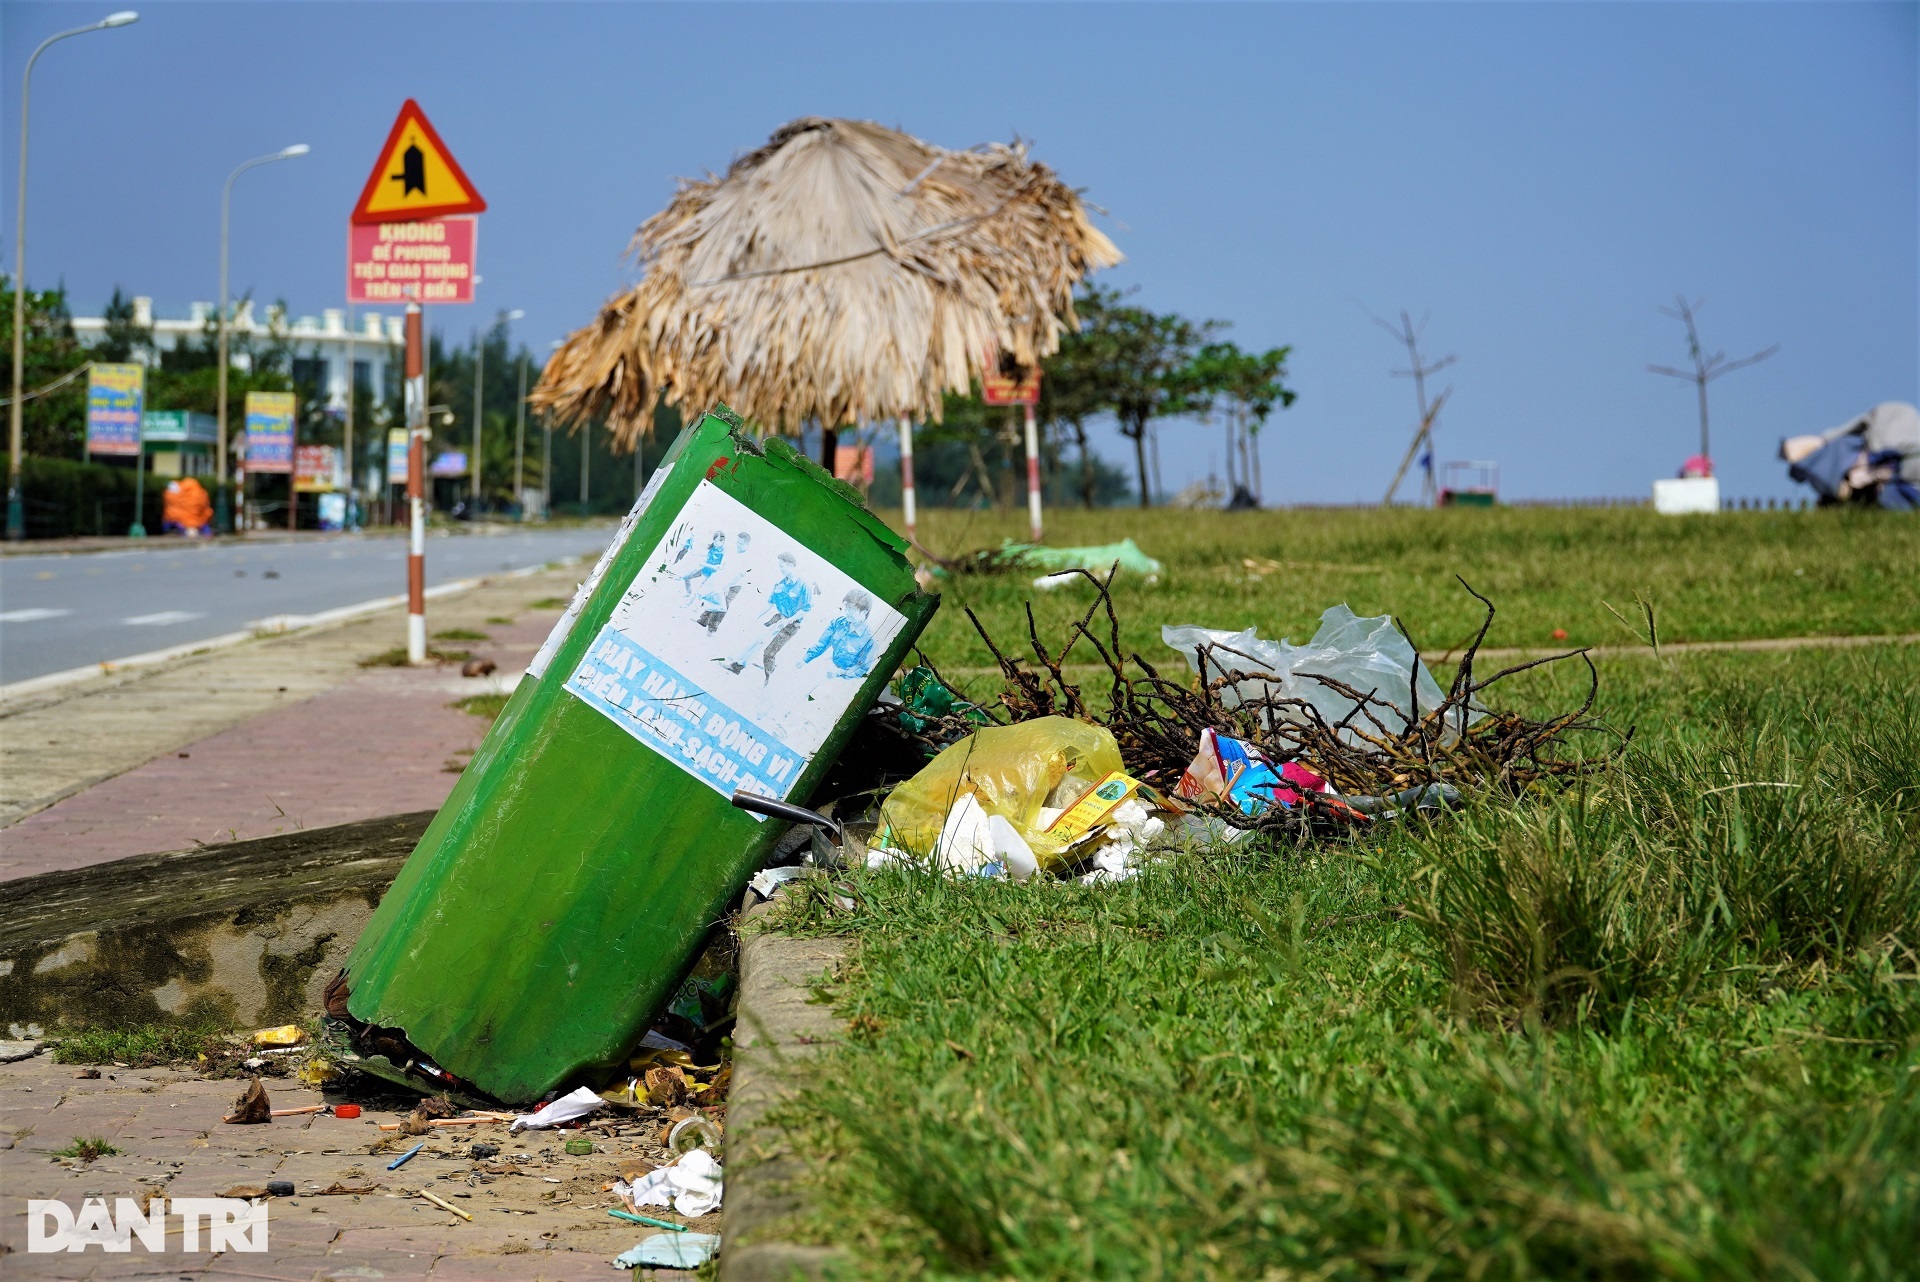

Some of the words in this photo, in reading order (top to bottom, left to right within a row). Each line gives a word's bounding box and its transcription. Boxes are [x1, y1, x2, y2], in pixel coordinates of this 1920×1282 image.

[379, 221, 445, 242] KHÔNG
[387, 262, 422, 279] GIAO
[597, 639, 648, 680] HÃY
[641, 671, 709, 726] HÀNH
[704, 712, 770, 767] ĐỘNG
[766, 754, 794, 783] VÌ
